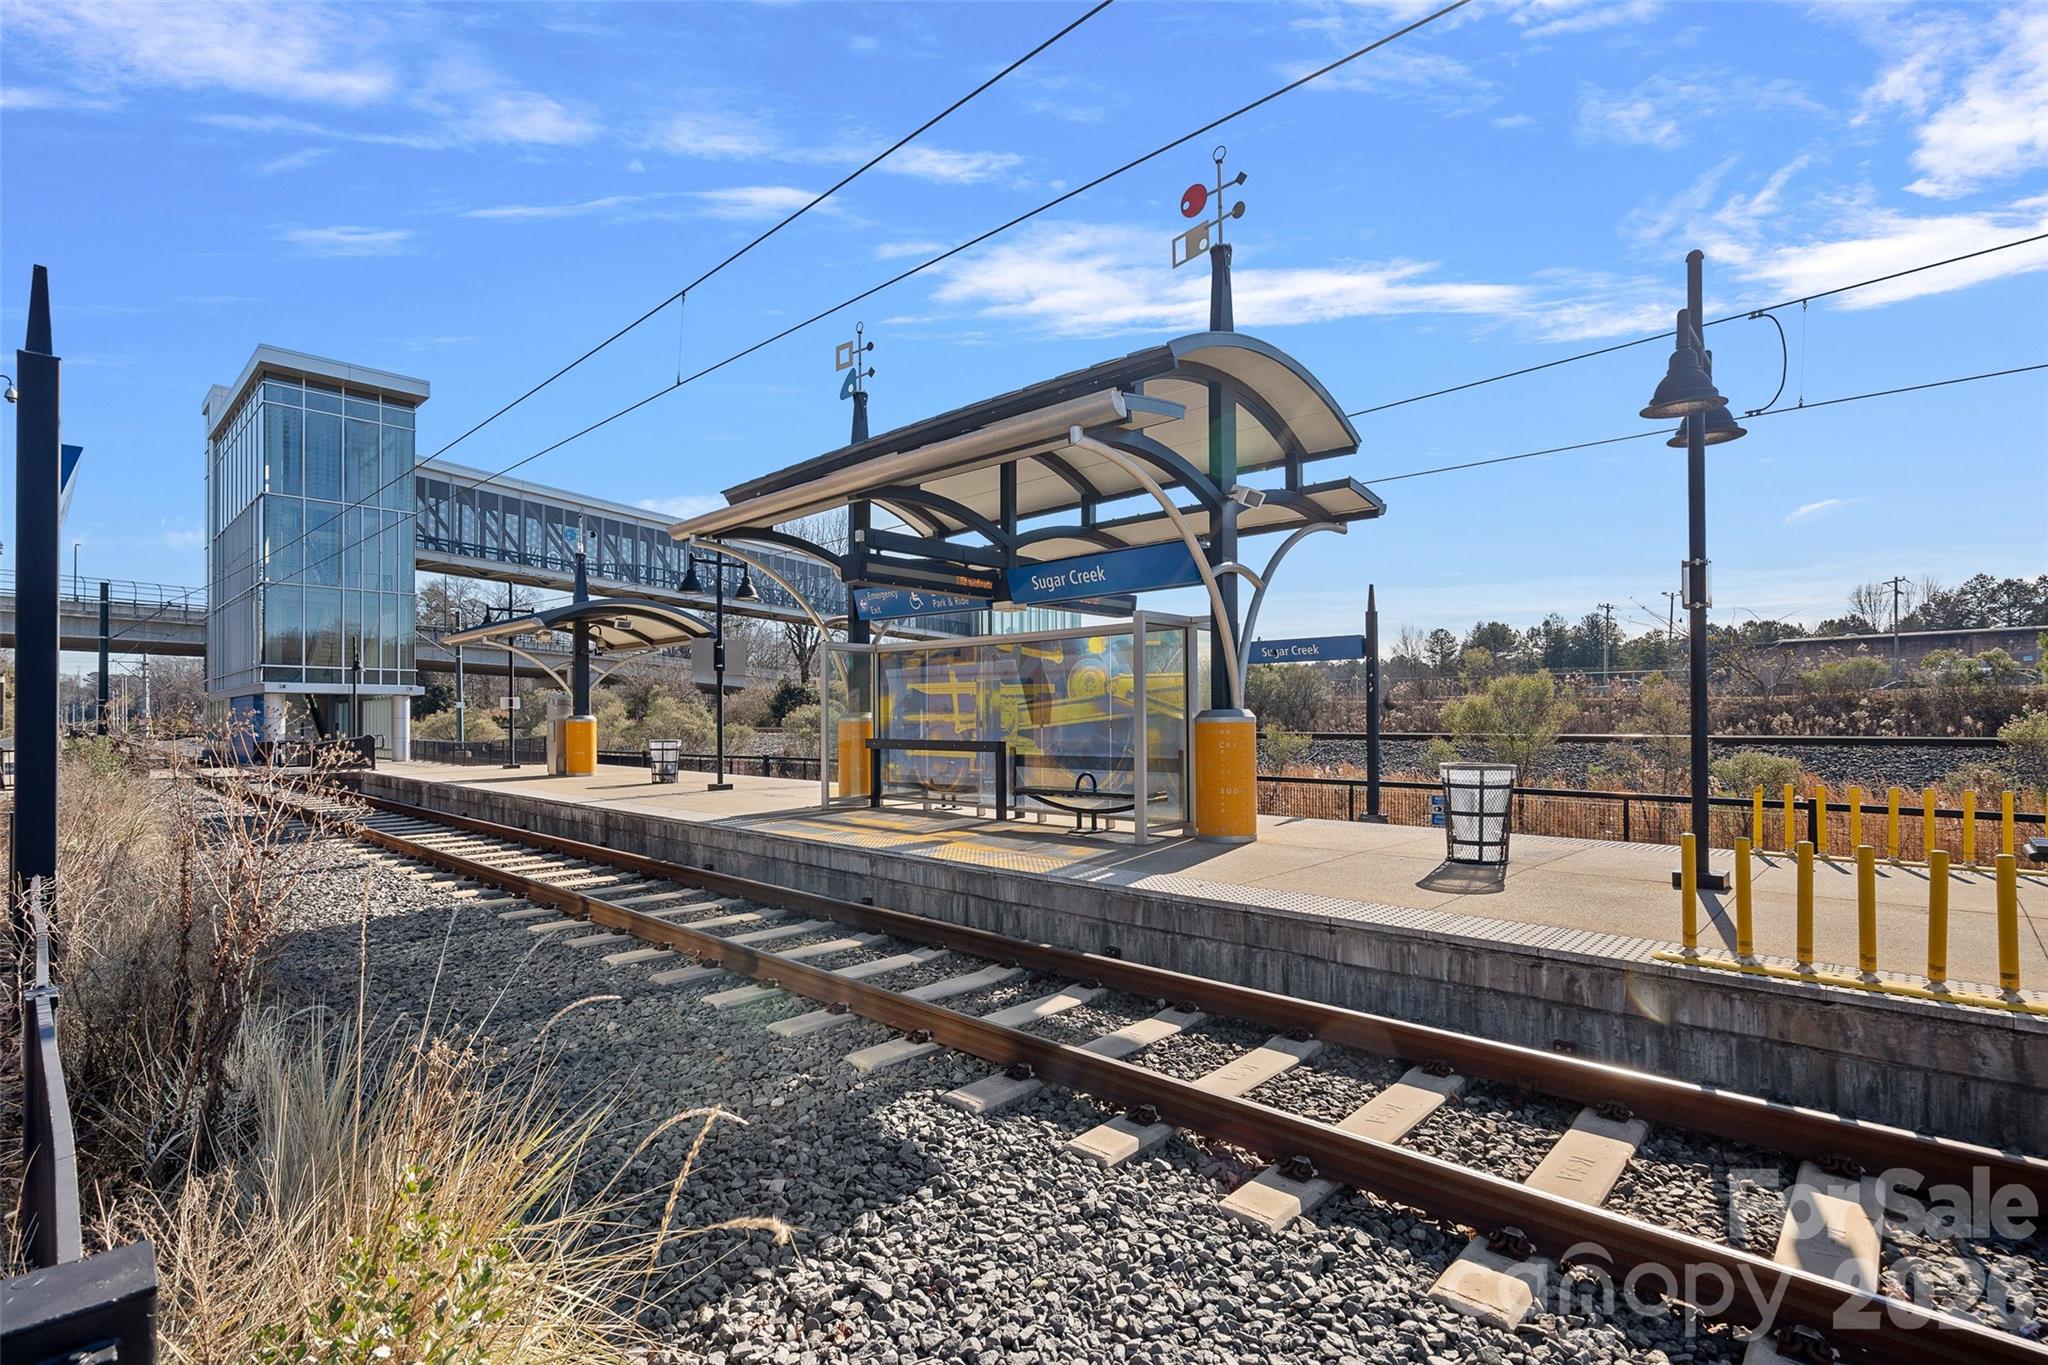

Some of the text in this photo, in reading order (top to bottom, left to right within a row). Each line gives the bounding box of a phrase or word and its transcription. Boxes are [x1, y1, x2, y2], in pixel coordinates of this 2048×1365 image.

[1031, 565, 1106, 592] Sugar Creek
[866, 590, 898, 601] Emergency
[932, 597, 946, 608] Park
[870, 605, 882, 615] Exit
[1291, 644, 1320, 656] Creek
